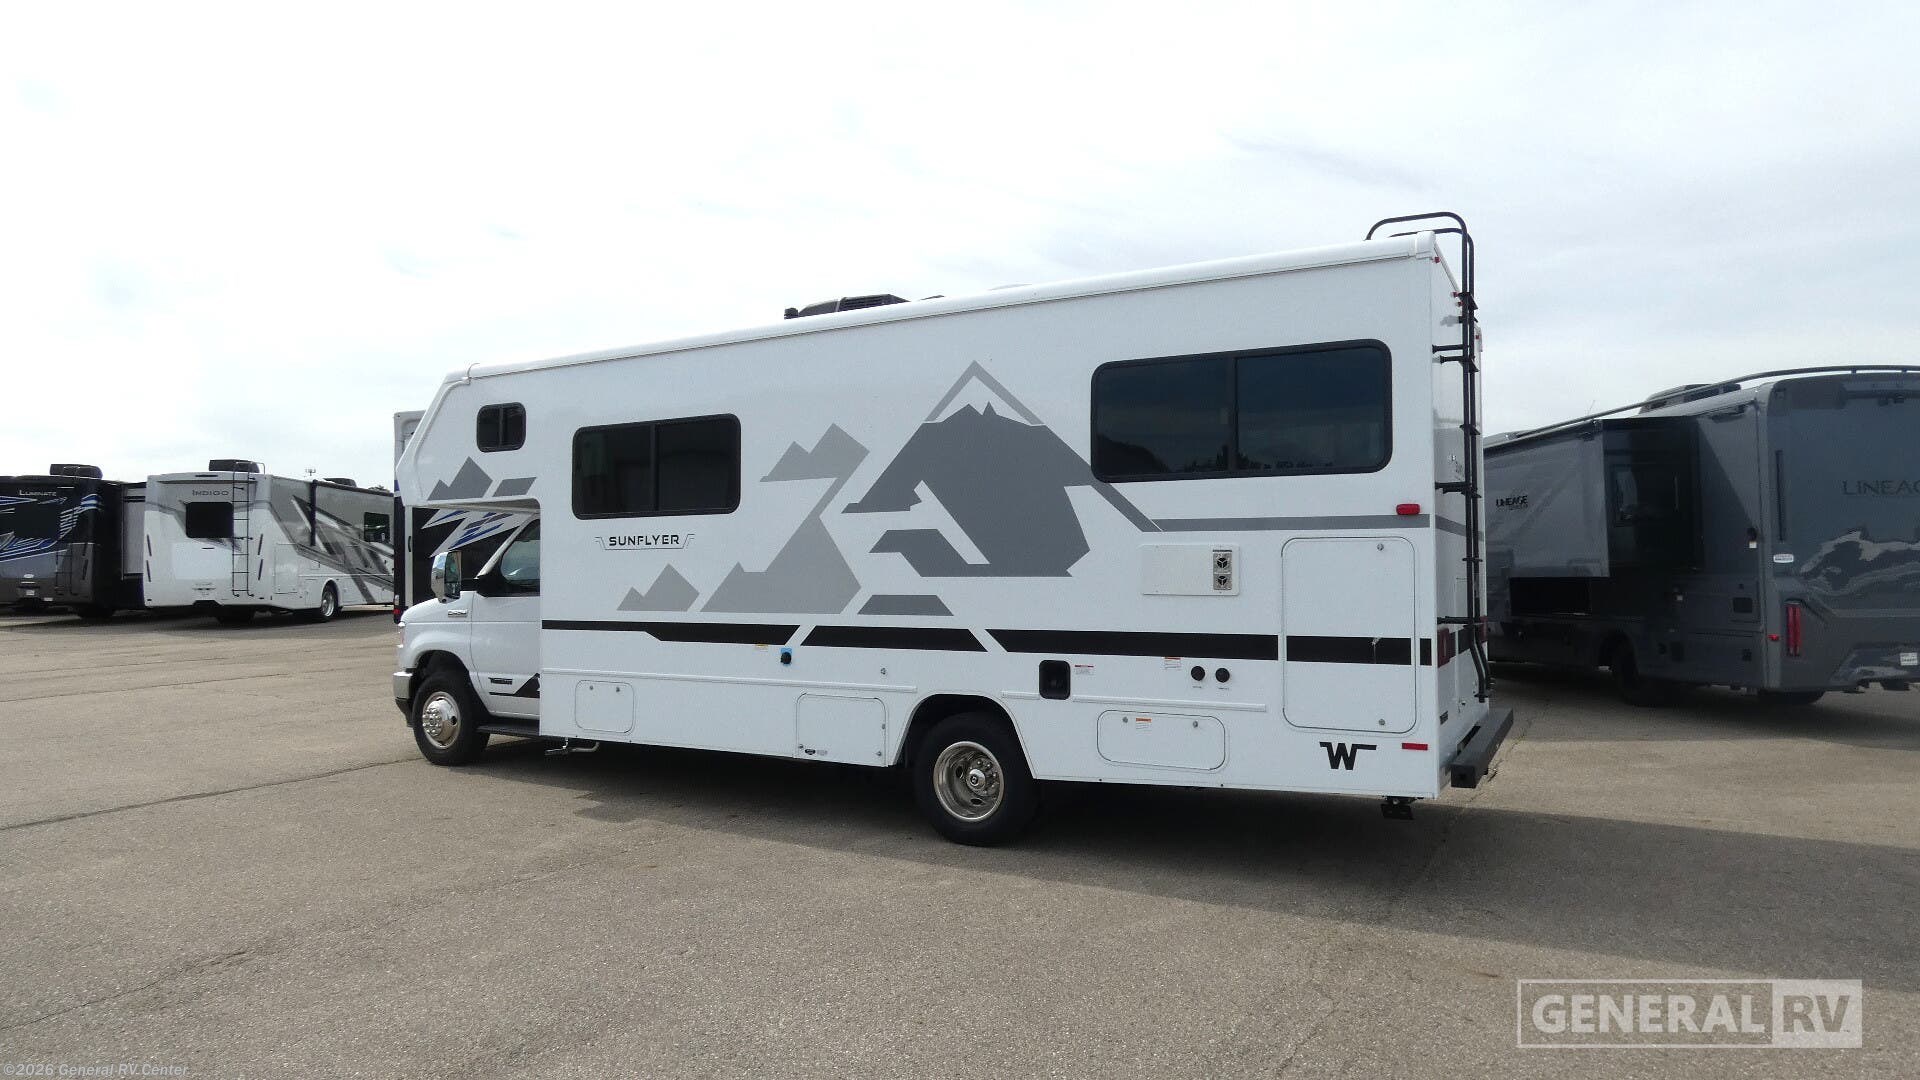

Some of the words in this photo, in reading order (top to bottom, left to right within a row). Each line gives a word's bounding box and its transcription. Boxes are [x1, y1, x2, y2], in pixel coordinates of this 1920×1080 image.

[192, 489, 229, 497] INDIGO
[608, 534, 680, 547] SUNFLYER
[1319, 741, 1377, 770] W
